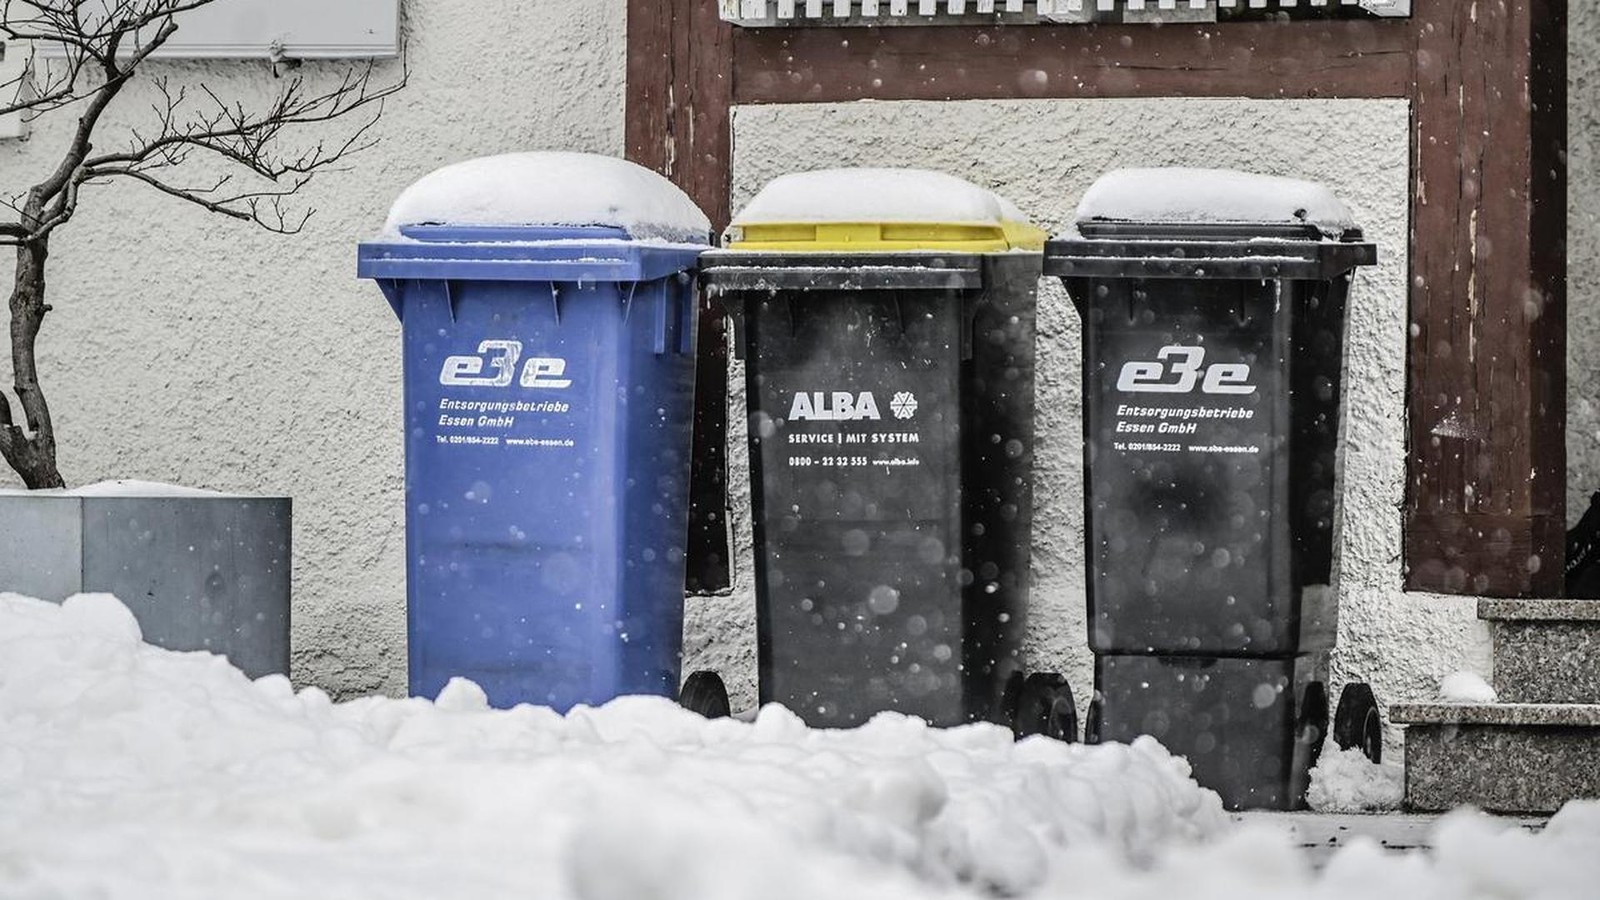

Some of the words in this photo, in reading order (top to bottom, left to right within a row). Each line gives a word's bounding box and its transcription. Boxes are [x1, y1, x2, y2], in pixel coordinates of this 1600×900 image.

[439, 398, 570, 413] Entsorgungsbetriebe
[788, 391, 881, 420] ALBA
[1116, 404, 1254, 419] Entsorgungsbetriebe
[438, 414, 475, 426] Essen
[477, 415, 515, 428] GmbH
[1115, 421, 1155, 433] Essen
[1158, 422, 1197, 434] GmbH
[436, 435, 449, 444] Tel.
[788, 433, 834, 444] SERVICE
[845, 433, 867, 443] MIT
[871, 433, 920, 443] SYSTEM
[1114, 442, 1126, 451] Tel.
[1128, 442, 1181, 452] 0201/854-2222
[788, 456, 812, 466] 0800
[822, 456, 834, 466] 22
[836, 456, 849, 466] 32
[850, 456, 868, 466] 555
